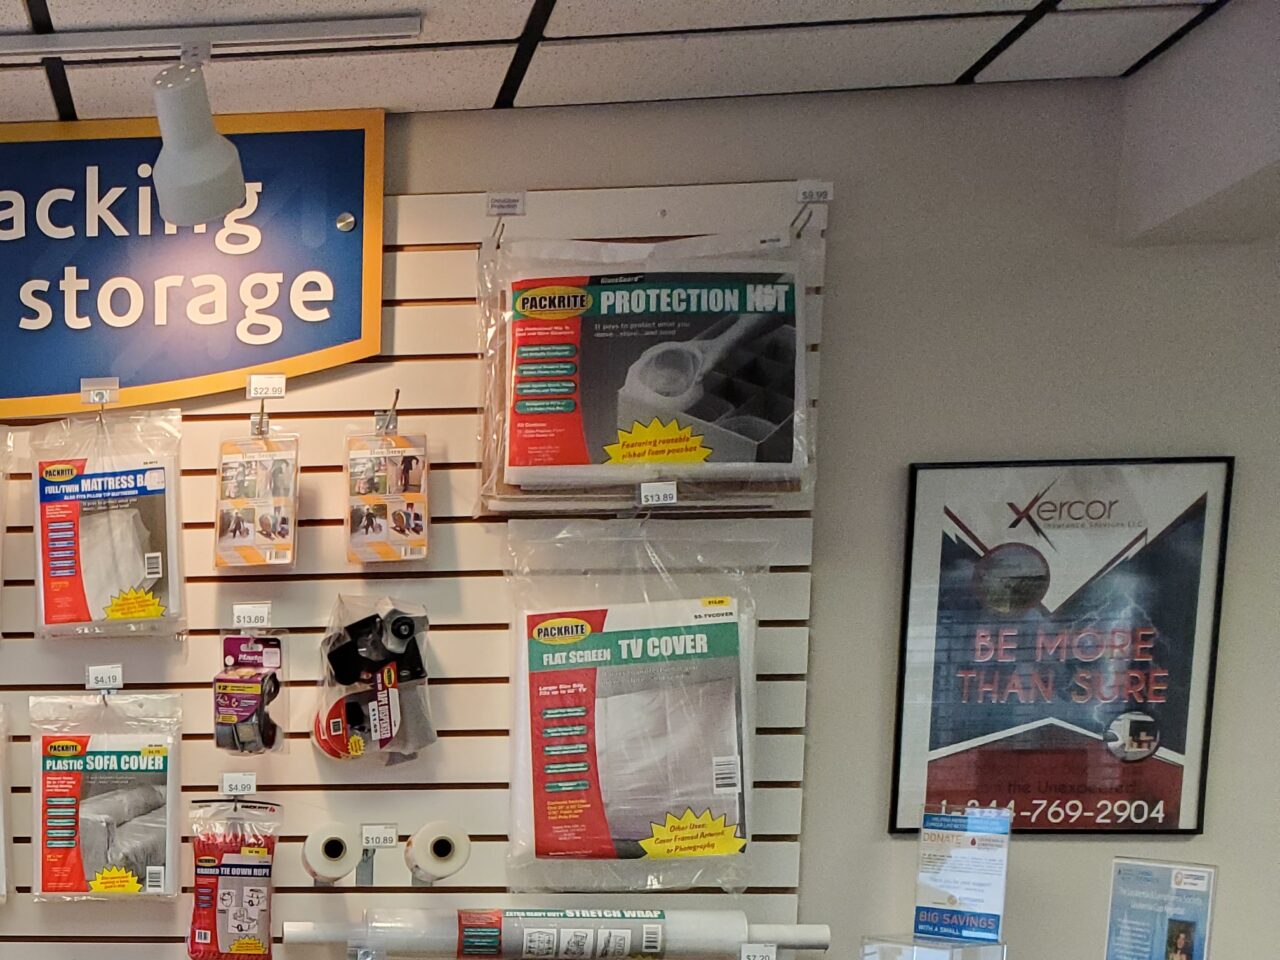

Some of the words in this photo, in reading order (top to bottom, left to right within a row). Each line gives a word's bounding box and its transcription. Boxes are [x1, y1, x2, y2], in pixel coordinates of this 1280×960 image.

[18, 268, 335, 346] storage
[521, 294, 587, 311] PACKRITE
[600, 289, 740, 315] PROTECTION
[253, 386, 283, 396] $22.99
[45, 469, 74, 478] PACKRITE
[45, 484, 79, 494] FULL/TWIN
[81, 475, 135, 492] MATTRESS
[644, 493, 674, 503] $13.89
[537, 624, 586, 639] PACKRITE
[543, 652, 568, 666] FLAT
[569, 649, 611, 664] SCREEN
[619, 638, 644, 659] TV
[647, 634, 708, 657] COVER
[974, 627, 1018, 663] BE
[1035, 627, 1158, 662] MORE
[94, 675, 117, 685] $4.19
[956, 670, 1053, 704] THAN
[1071, 669, 1169, 704] SURE
[49, 743, 79, 753] PACKRITE
[46, 759, 83, 771] PLASTIC
[86, 755, 118, 770] SOFA
[121, 754, 164, 770] COVER
[228, 783, 251, 792] $4.99
[364, 835, 393, 845] $10.89
[923, 832, 963, 845] DONATE
[919, 911, 939, 924] BIG
[942, 912, 996, 930] SAVINGS
